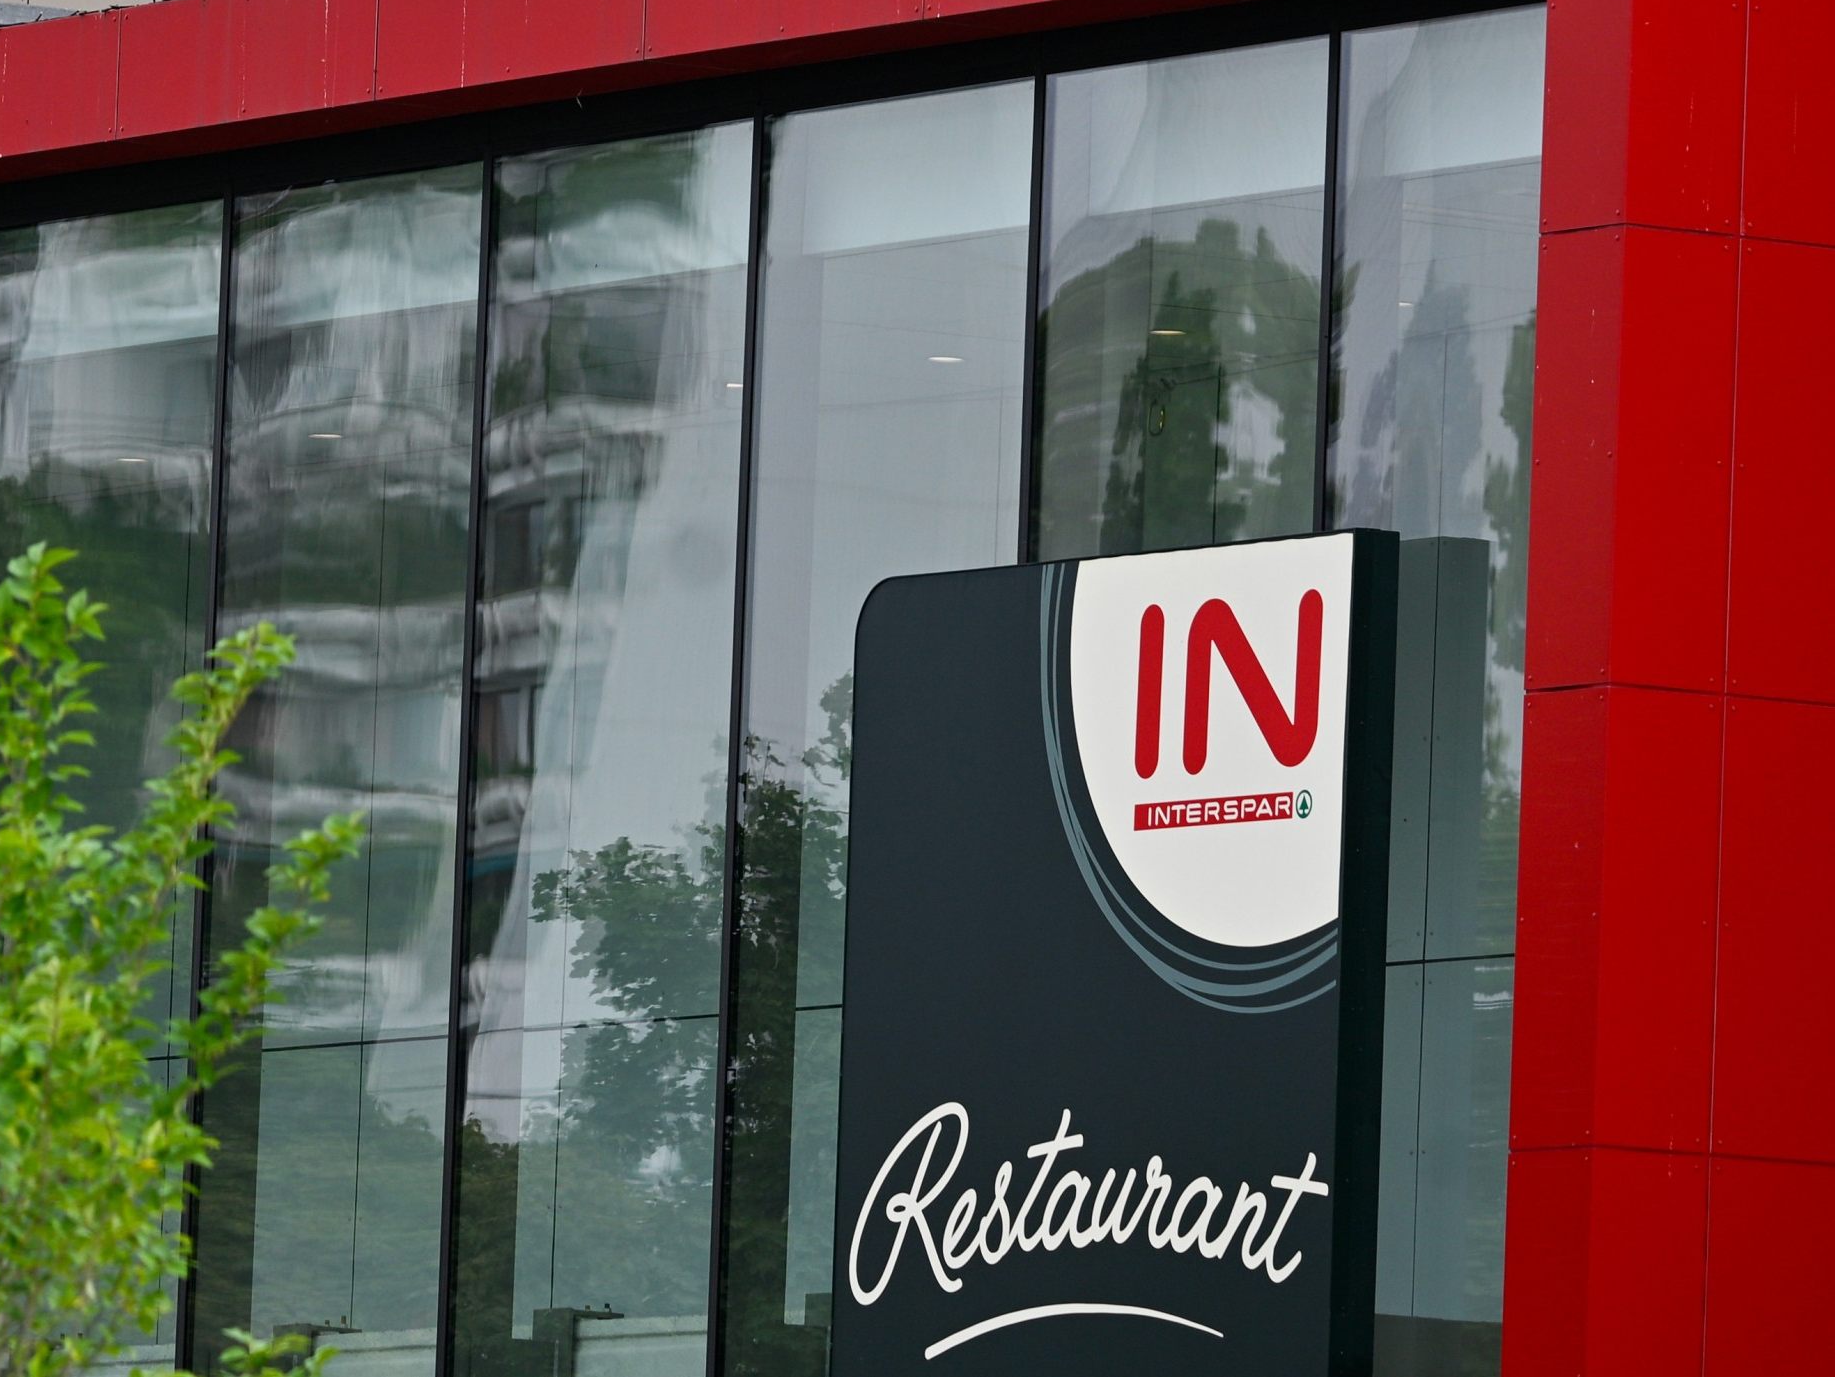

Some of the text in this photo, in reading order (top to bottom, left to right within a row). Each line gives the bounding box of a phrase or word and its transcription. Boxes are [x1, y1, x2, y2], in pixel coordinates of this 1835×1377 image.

[1134, 588, 1324, 780] IN
[1146, 795, 1292, 827] INTERSPAR
[849, 1101, 1329, 1305] Restaurant
